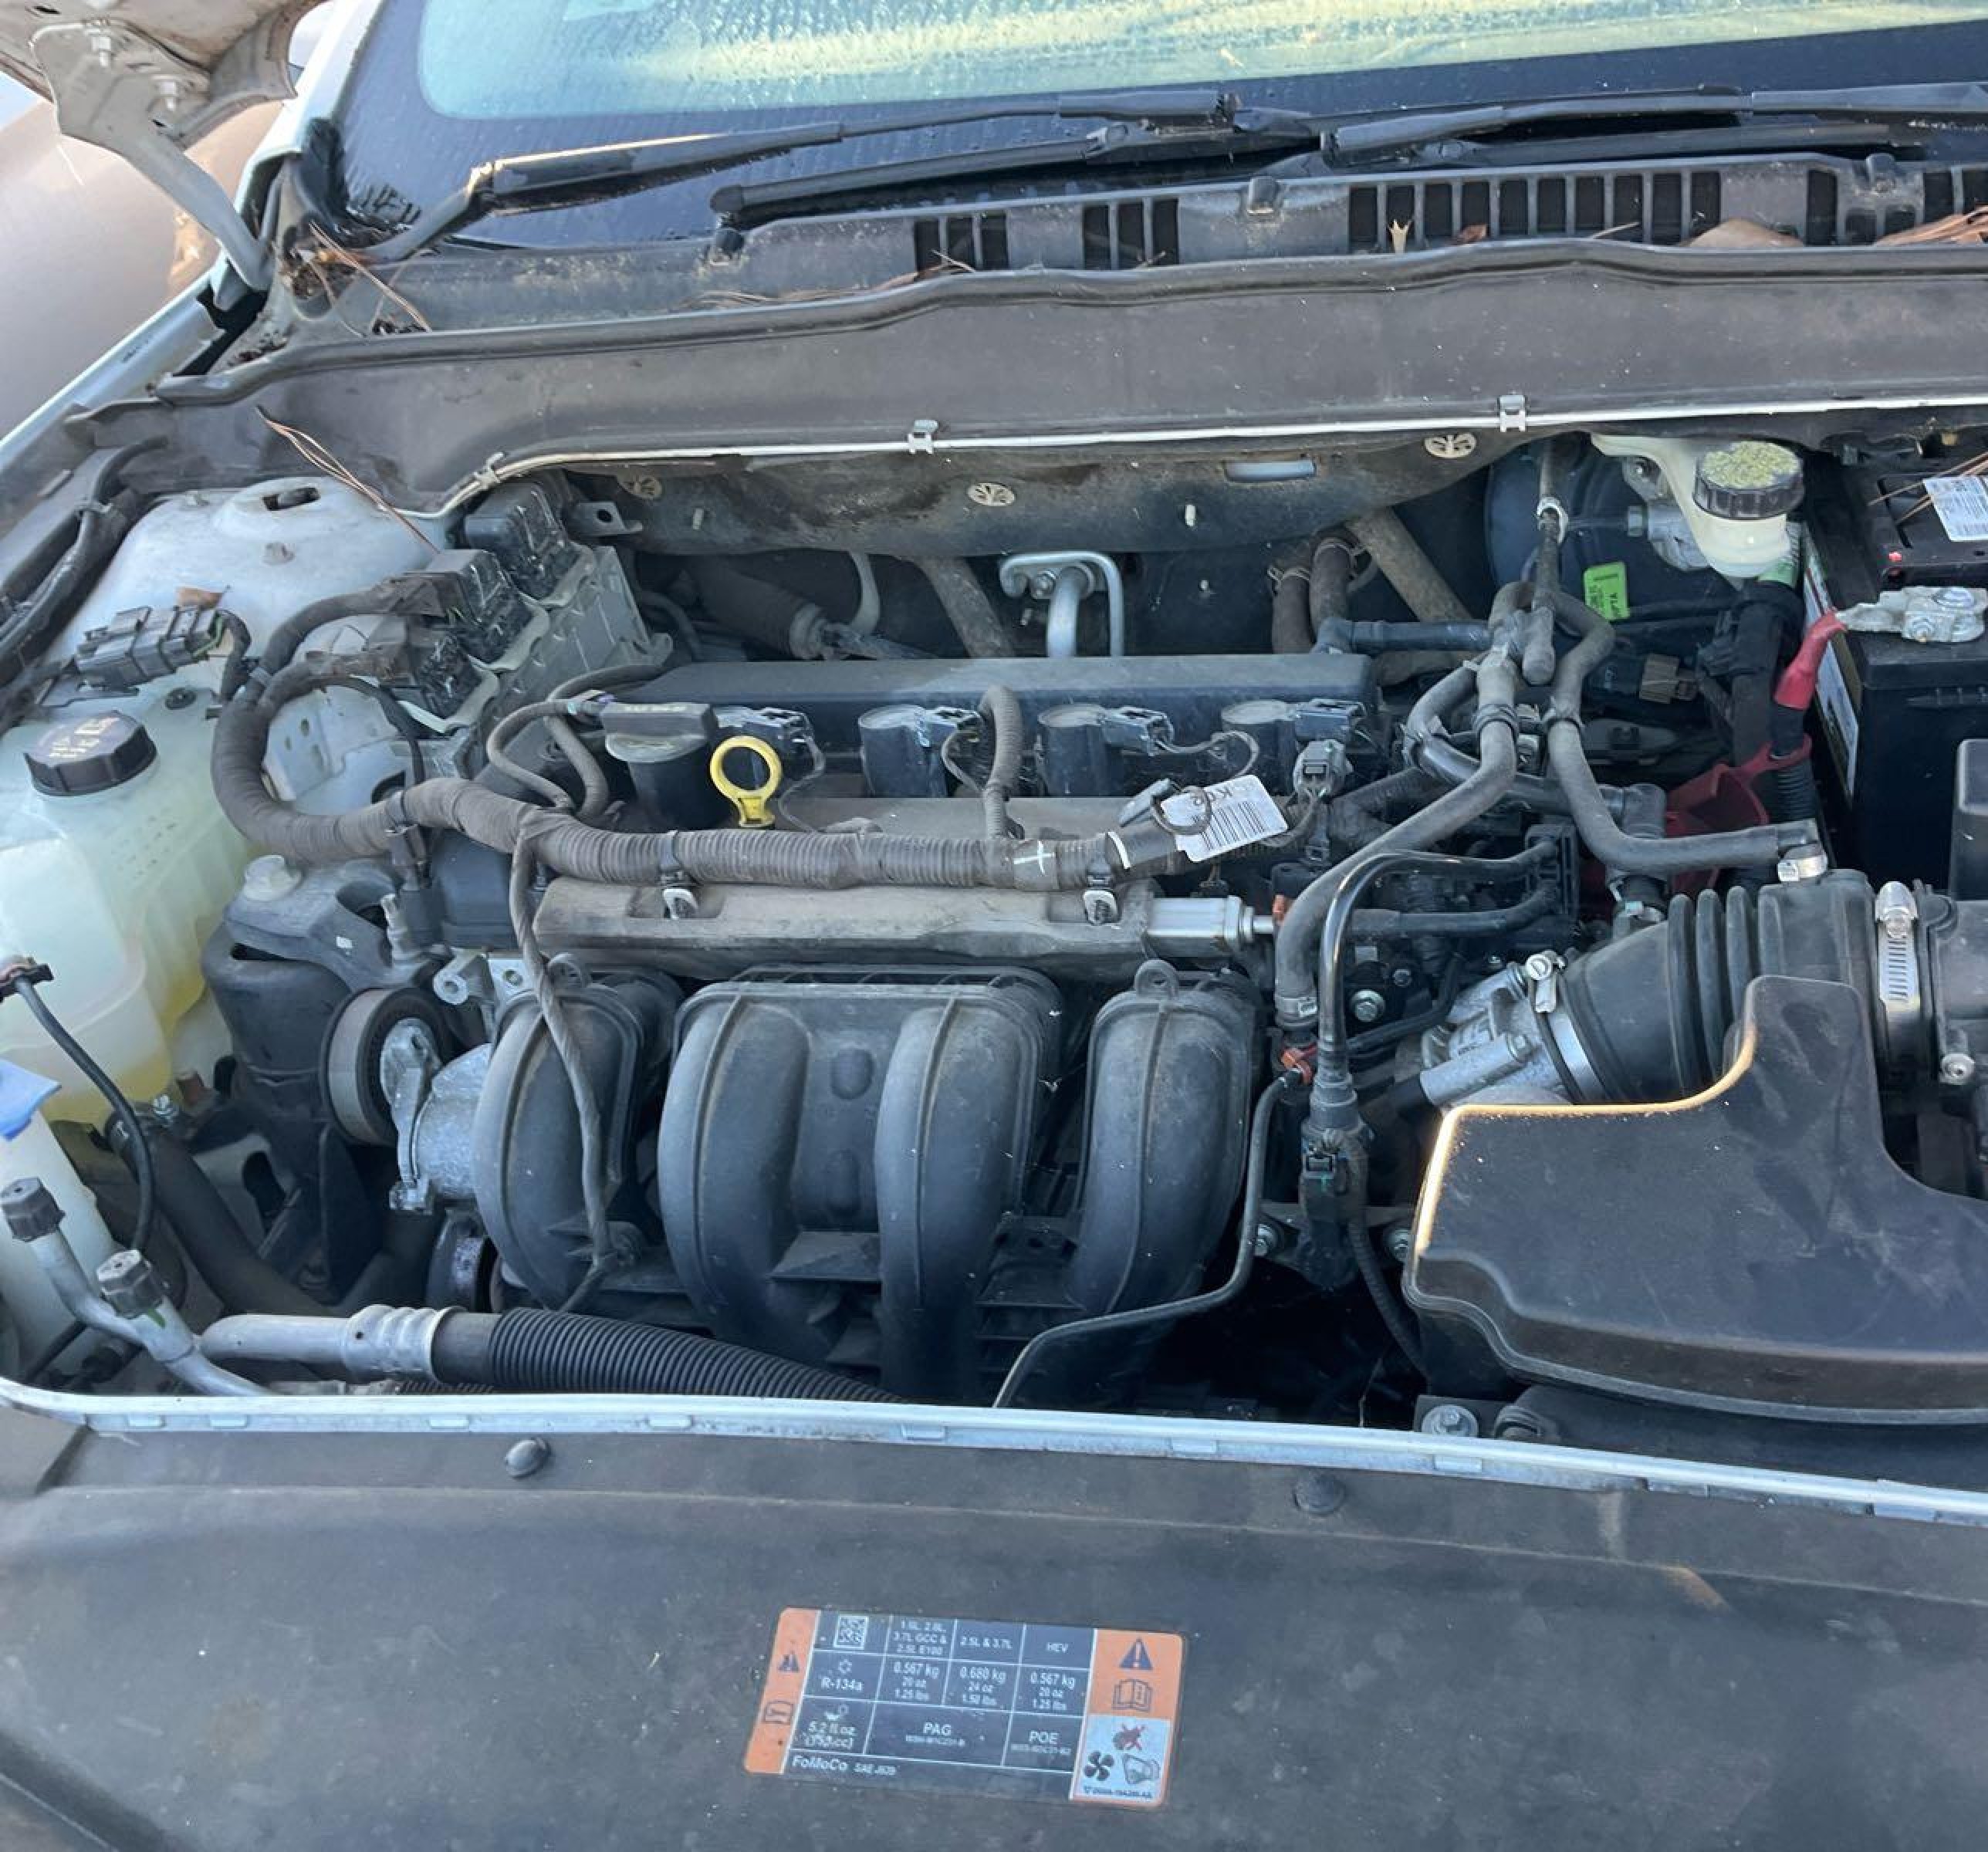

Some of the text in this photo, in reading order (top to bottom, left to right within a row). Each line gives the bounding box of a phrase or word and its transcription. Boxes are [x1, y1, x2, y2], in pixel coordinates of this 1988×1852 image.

[894, 1661, 940, 1679] 0.567 kg
[959, 1666, 1007, 1685] 0.680 kg
[820, 1677, 864, 1691] R-134a
[1030, 1671, 1077, 1690] 0.567 kg
[922, 1722, 952, 1736] PAG
[1029, 1730, 1060, 1745] POE
[792, 1755, 849, 1771] FoMoCo
